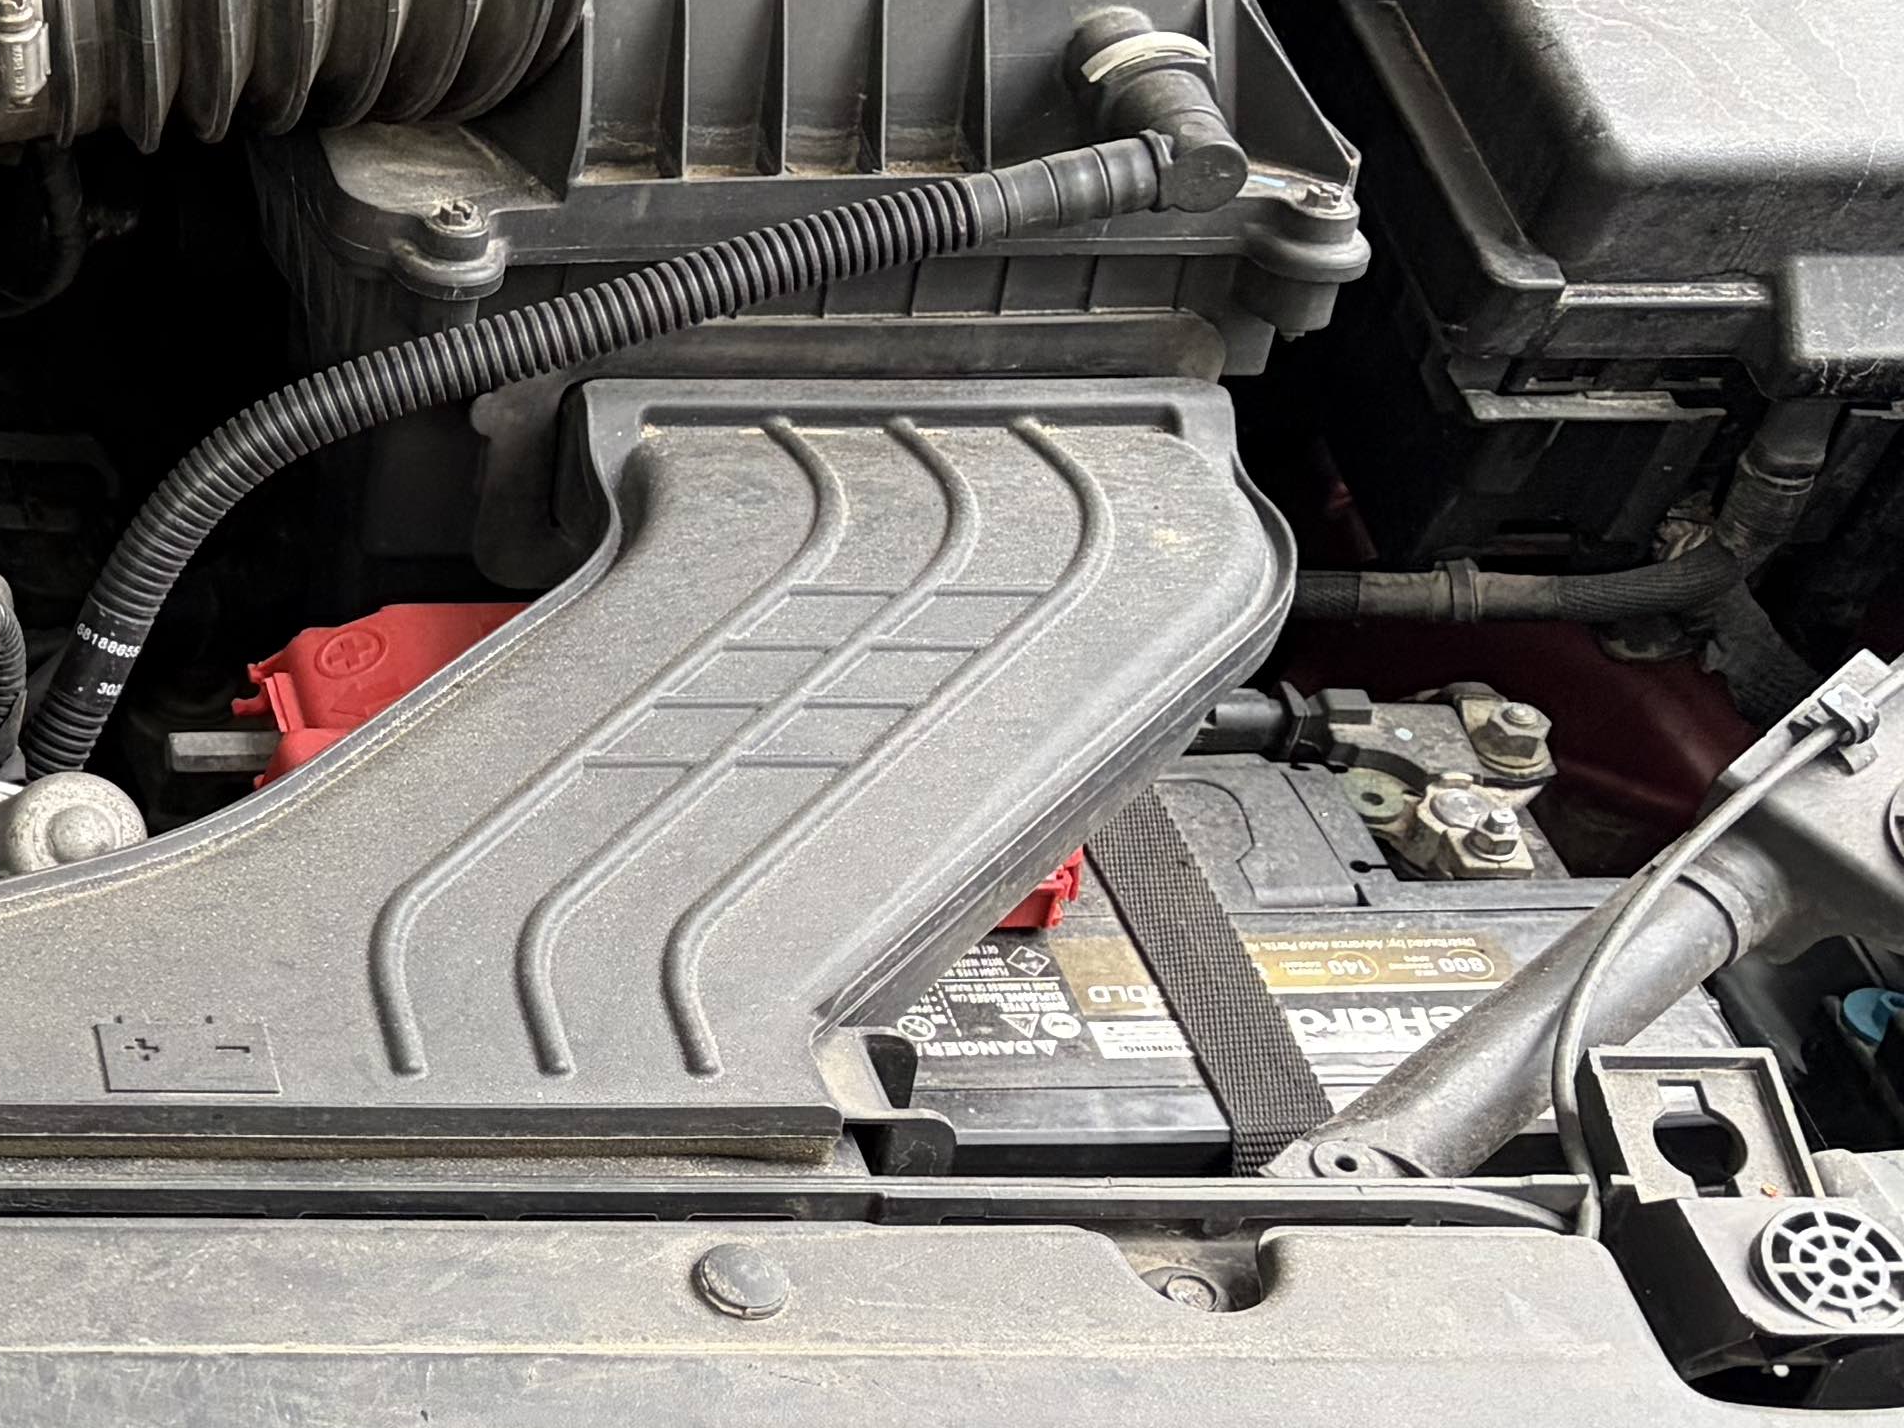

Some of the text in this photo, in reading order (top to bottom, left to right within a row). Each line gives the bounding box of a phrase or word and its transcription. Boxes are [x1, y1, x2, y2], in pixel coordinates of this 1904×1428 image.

[1298, 941, 1329, 950] Auto
[1330, 940, 1384, 950] Advance
[1438, 957, 1486, 973] 800
[1285, 1005, 1473, 1042] eHard
[1118, 1045, 1187, 1053] ARNING!
